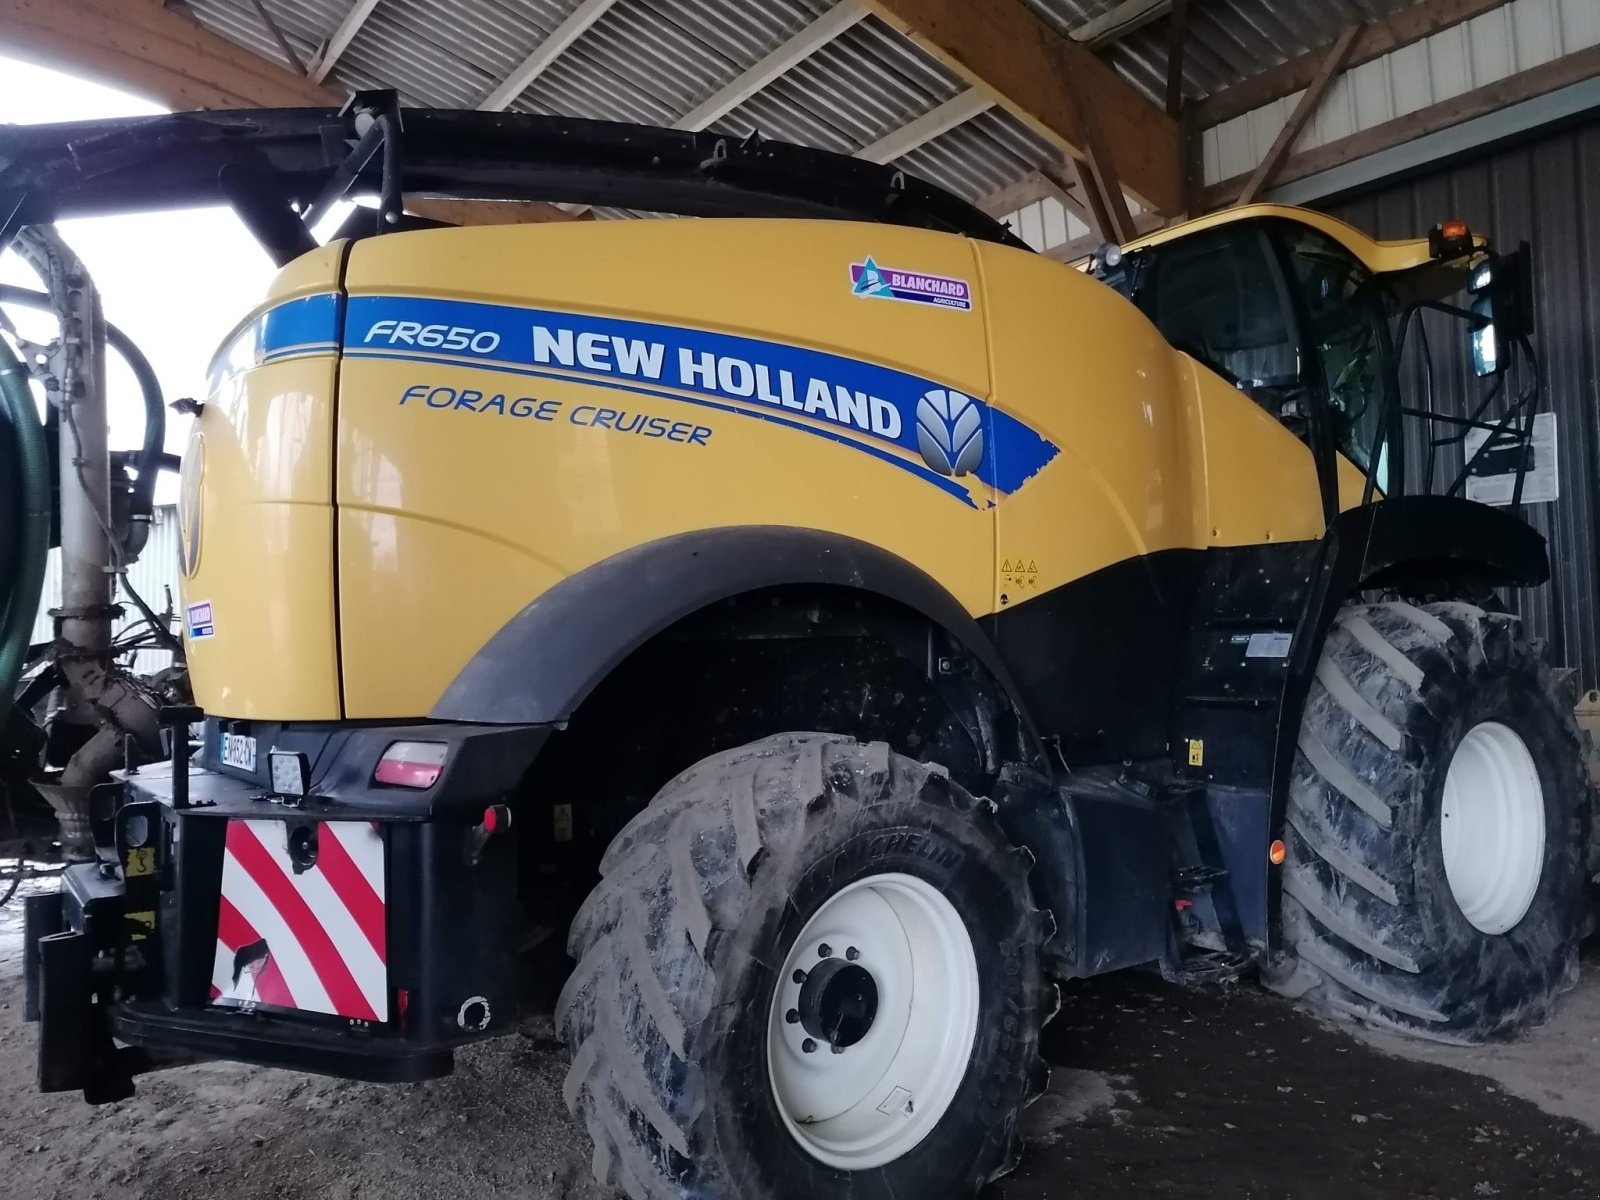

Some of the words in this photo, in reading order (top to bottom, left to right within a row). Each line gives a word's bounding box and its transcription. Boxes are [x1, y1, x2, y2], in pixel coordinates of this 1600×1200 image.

[891, 273, 965, 297] BLANCHARD
[932, 296, 967, 308] AGRICULTURE
[363, 319, 501, 354] FR650
[532, 325, 666, 380] NEW
[678, 347, 903, 440] HOLLAND
[399, 384, 563, 422] FORAGE
[569, 405, 714, 447] CRUISER
